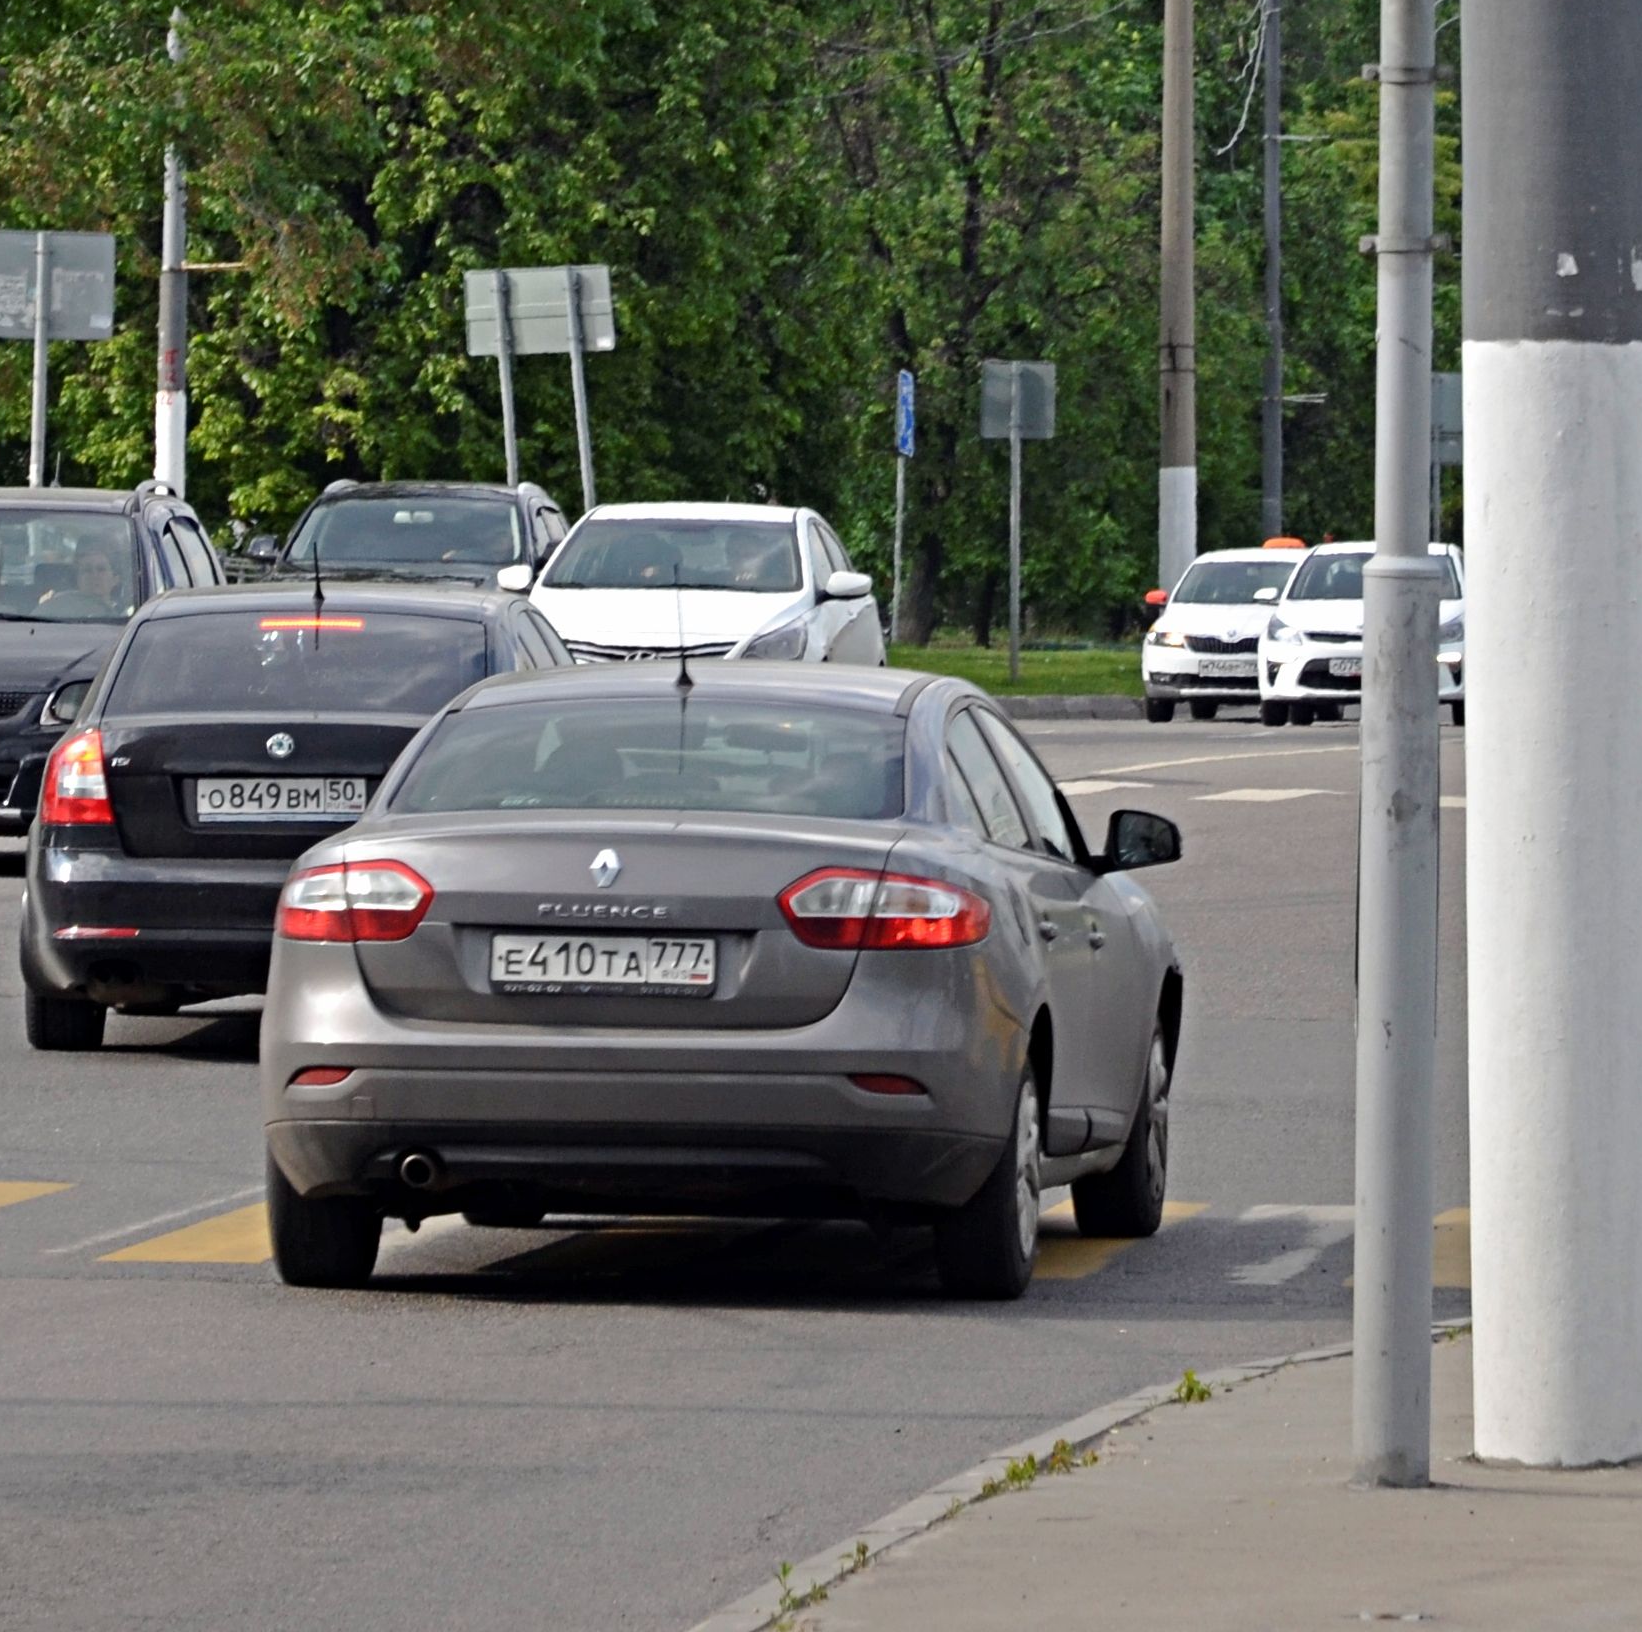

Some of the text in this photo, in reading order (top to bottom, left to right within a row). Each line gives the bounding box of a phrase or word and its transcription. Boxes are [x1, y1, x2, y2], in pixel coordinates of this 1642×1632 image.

[208, 780, 356, 809] О849ВМ 50
[537, 903, 669, 919] FLUENCE
[504, 941, 706, 978] Е410ТА 777
[661, 969, 688, 980] RUS
